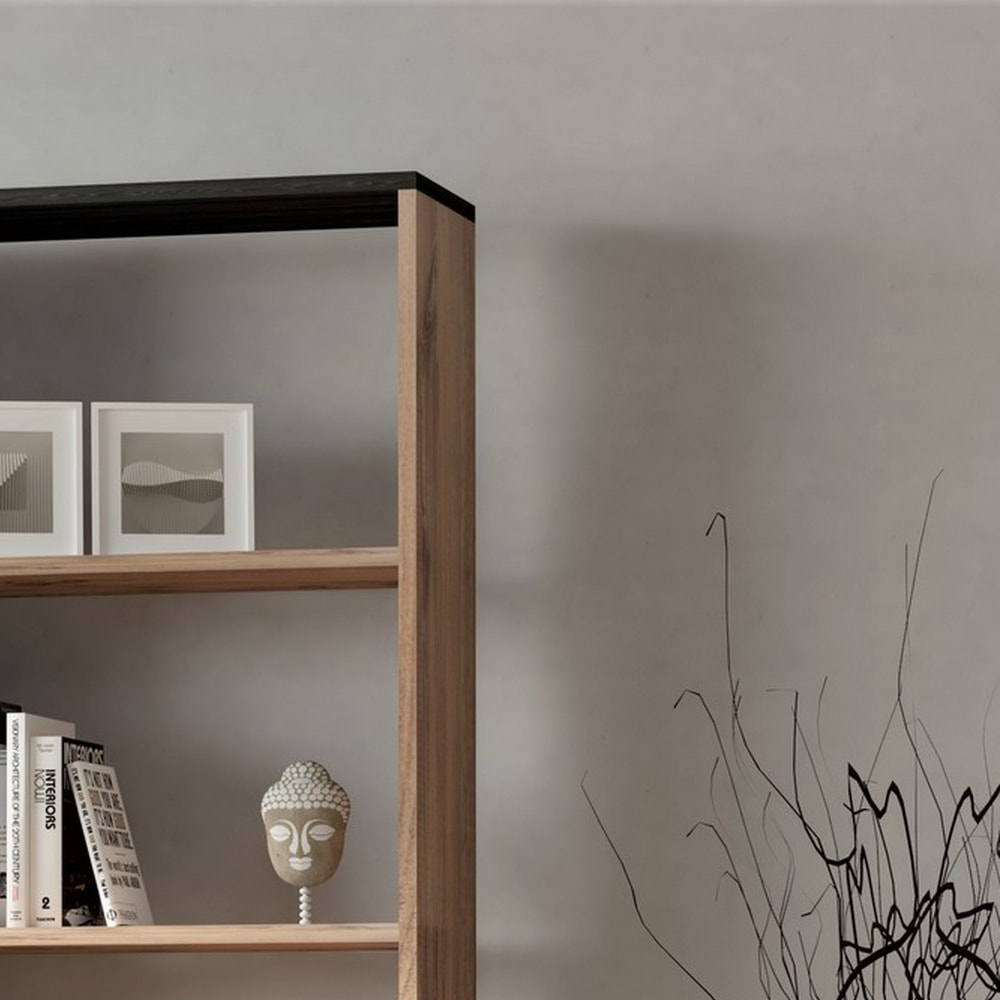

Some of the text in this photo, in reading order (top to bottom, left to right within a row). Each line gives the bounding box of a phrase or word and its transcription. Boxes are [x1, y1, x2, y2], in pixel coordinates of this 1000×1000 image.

[11, 719, 19, 751] VISIONARY
[11, 752, 19, 802] ARCHITECTURE
[34, 769, 45, 803] NOW!
[11, 803, 19, 813] OF
[45, 769, 56, 830] INTERIORS
[11, 814, 19, 827] THE
[11, 828, 19, 849] 20TH
[11, 850, 19, 885] CENTURY
[42, 897, 50, 910] 2
